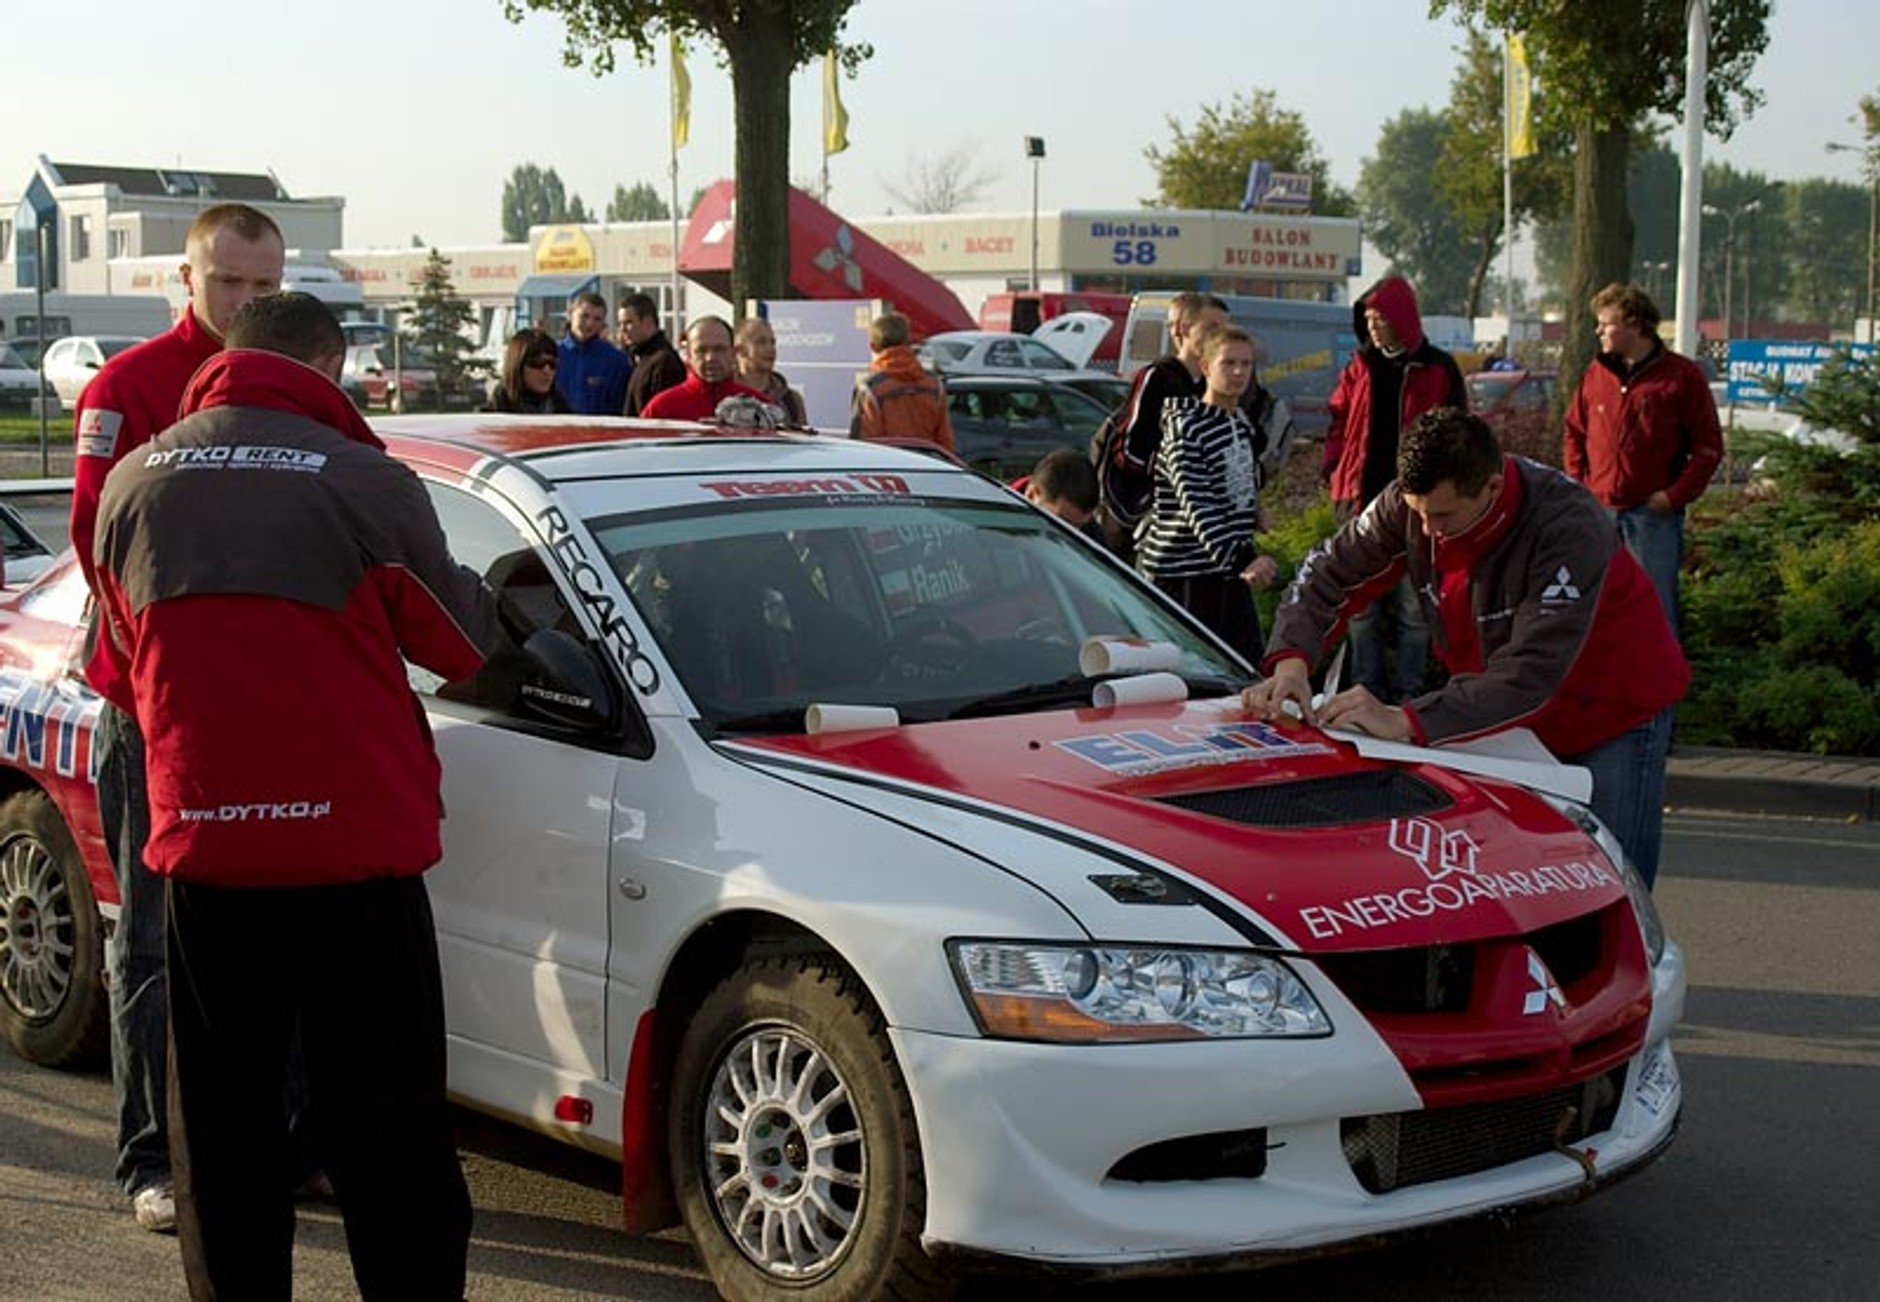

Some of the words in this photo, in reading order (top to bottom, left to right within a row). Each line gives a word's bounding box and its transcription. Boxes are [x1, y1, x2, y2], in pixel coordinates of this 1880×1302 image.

[1091, 223, 1181, 238] Bielska
[1252, 228, 1311, 246] SALON
[1113, 240, 1157, 265] 58
[144, 446, 231, 468] DYTKO
[246, 448, 311, 463] RENT
[537, 505, 661, 696] RECARO
[179, 801, 331, 821] www.DYTKO.pl
[1300, 860, 1617, 940] ENERGOAPARATURA
